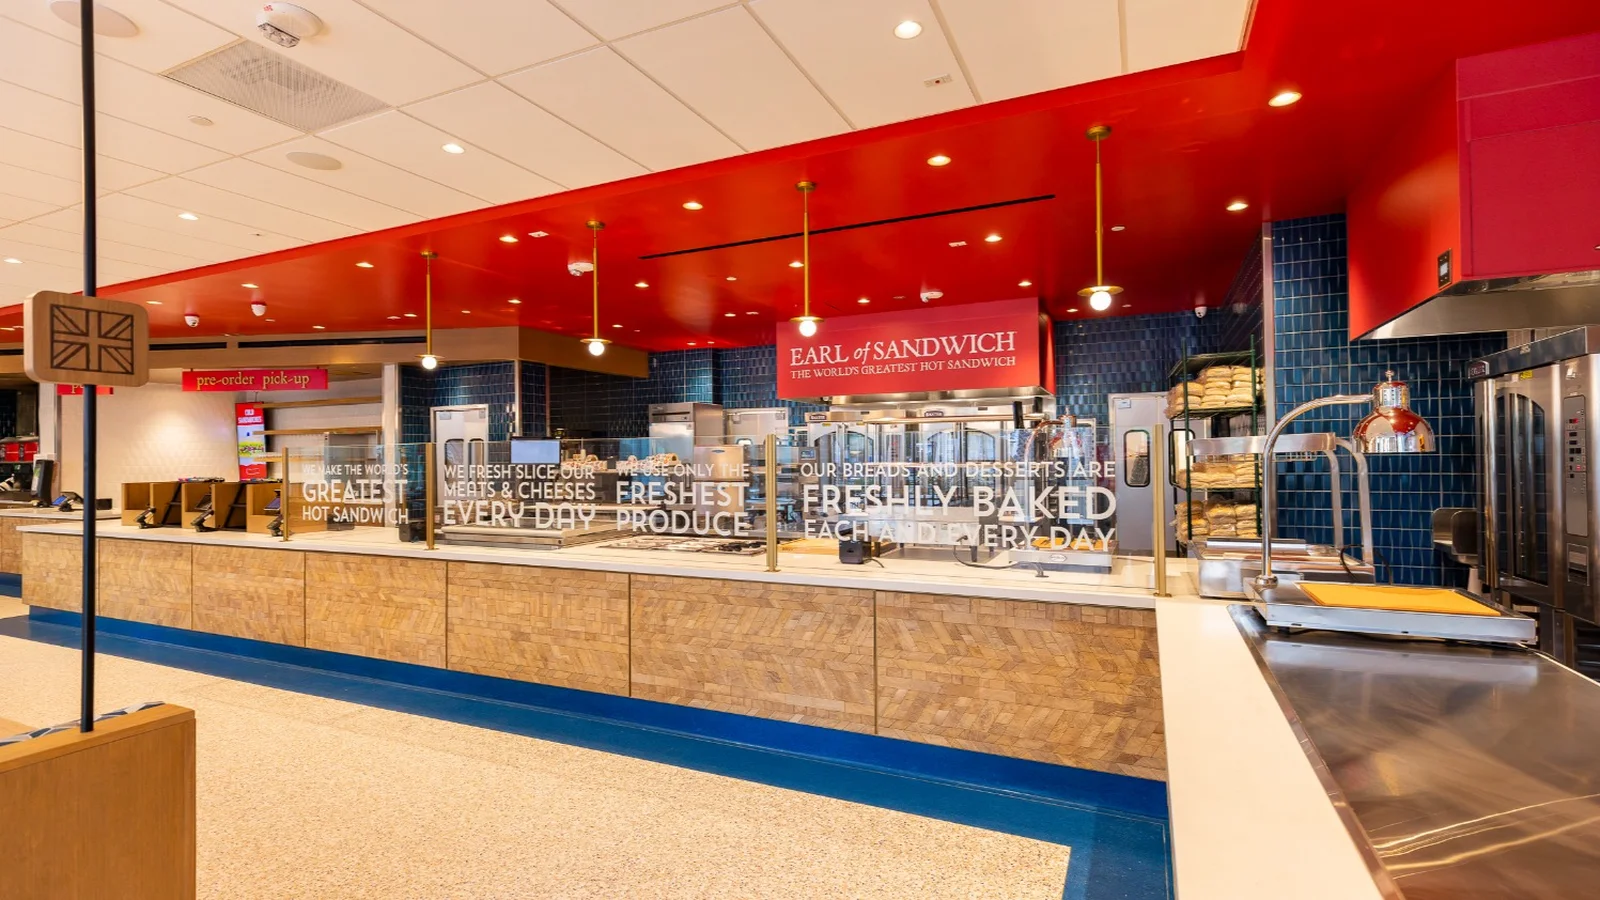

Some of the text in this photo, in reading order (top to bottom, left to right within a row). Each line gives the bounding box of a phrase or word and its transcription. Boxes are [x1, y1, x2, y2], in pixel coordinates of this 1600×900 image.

[790, 331, 1017, 366] EARL of SANDWICH
[791, 356, 1016, 379] THE WORLD'S GREATEST HOT SANDWICH
[196, 371, 310, 391] pre-order pick-up
[344, 464, 362, 475] THE
[444, 464, 596, 480] WE FRESH SLICE OUR
[616, 463, 751, 477] WE USE ONLY THE
[800, 461, 1116, 478] OUR BREADS AND DESSERTS ARE
[302, 479, 408, 504] GREATEST
[444, 480, 596, 500] MEATS & CHEESES
[616, 481, 750, 506] FRESHEST
[803, 484, 1117, 520] FRESHLY BAKED
[302, 505, 409, 525] HOT SANDWICH
[443, 499, 597, 531] EVERY DAY
[616, 509, 749, 537] PRODUCE
[804, 519, 1116, 552] EACH AND EVERY DAY
